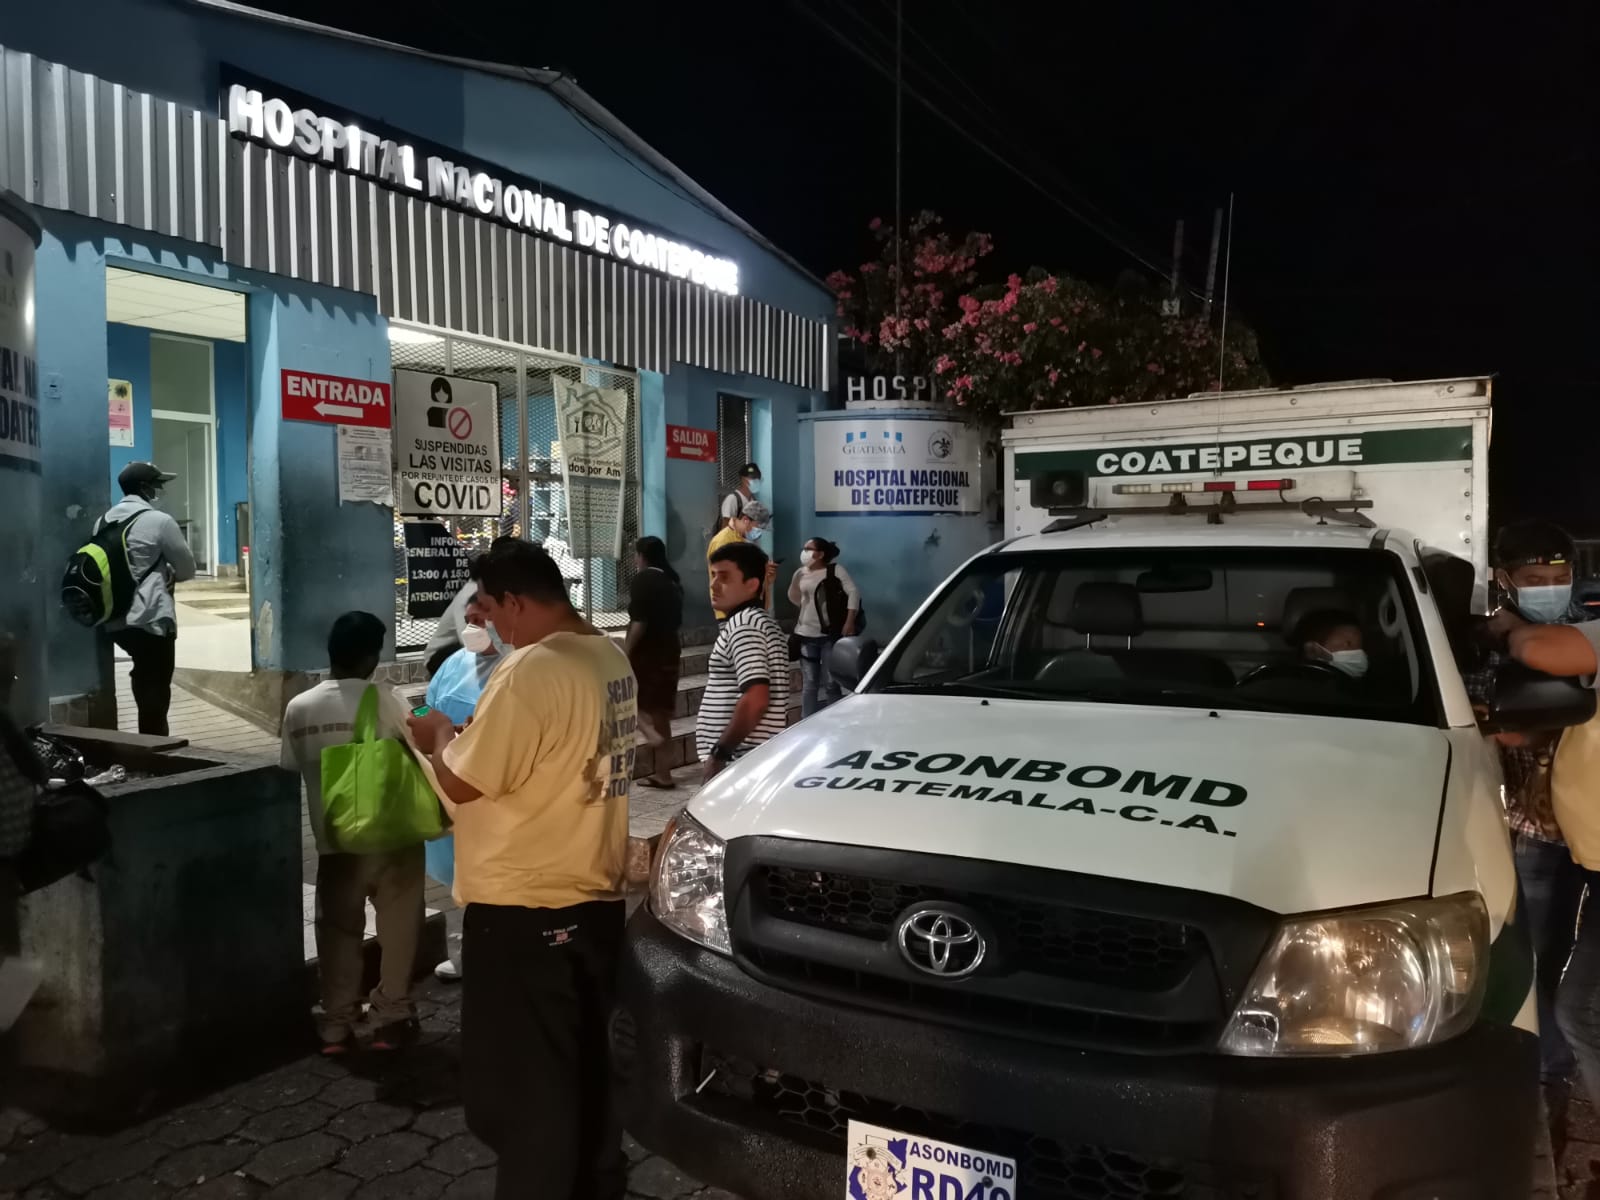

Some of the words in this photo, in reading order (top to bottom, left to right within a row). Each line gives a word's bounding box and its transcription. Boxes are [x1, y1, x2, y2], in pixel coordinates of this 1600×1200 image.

[229, 84, 422, 191] HOSPITAL
[427, 156, 573, 242] NACIONAL
[573, 209, 610, 254] DE
[0, 347, 21, 395] AL
[286, 375, 386, 407] ENTRADA
[415, 439, 488, 456] SUSPENDIDAS
[672, 429, 709, 447] SALIDA
[409, 453, 437, 470] LAS
[440, 456, 493, 474] VISITAS
[587, 466, 602, 476] por
[1096, 438, 1363, 474] COATEPEQUE
[401, 471, 420, 480] POR
[834, 470, 906, 487] HOSPITAL
[910, 470, 970, 488] NACIONAL
[414, 481, 492, 511] COVID
[851, 489, 870, 506] DE
[874, 489, 959, 508] COATEPEQUE
[826, 750, 1248, 807] ASONBOMD
[794, 777, 1239, 837] GUATEMALA-C.A.
[909, 1142, 1014, 1180] ASONBOMD
